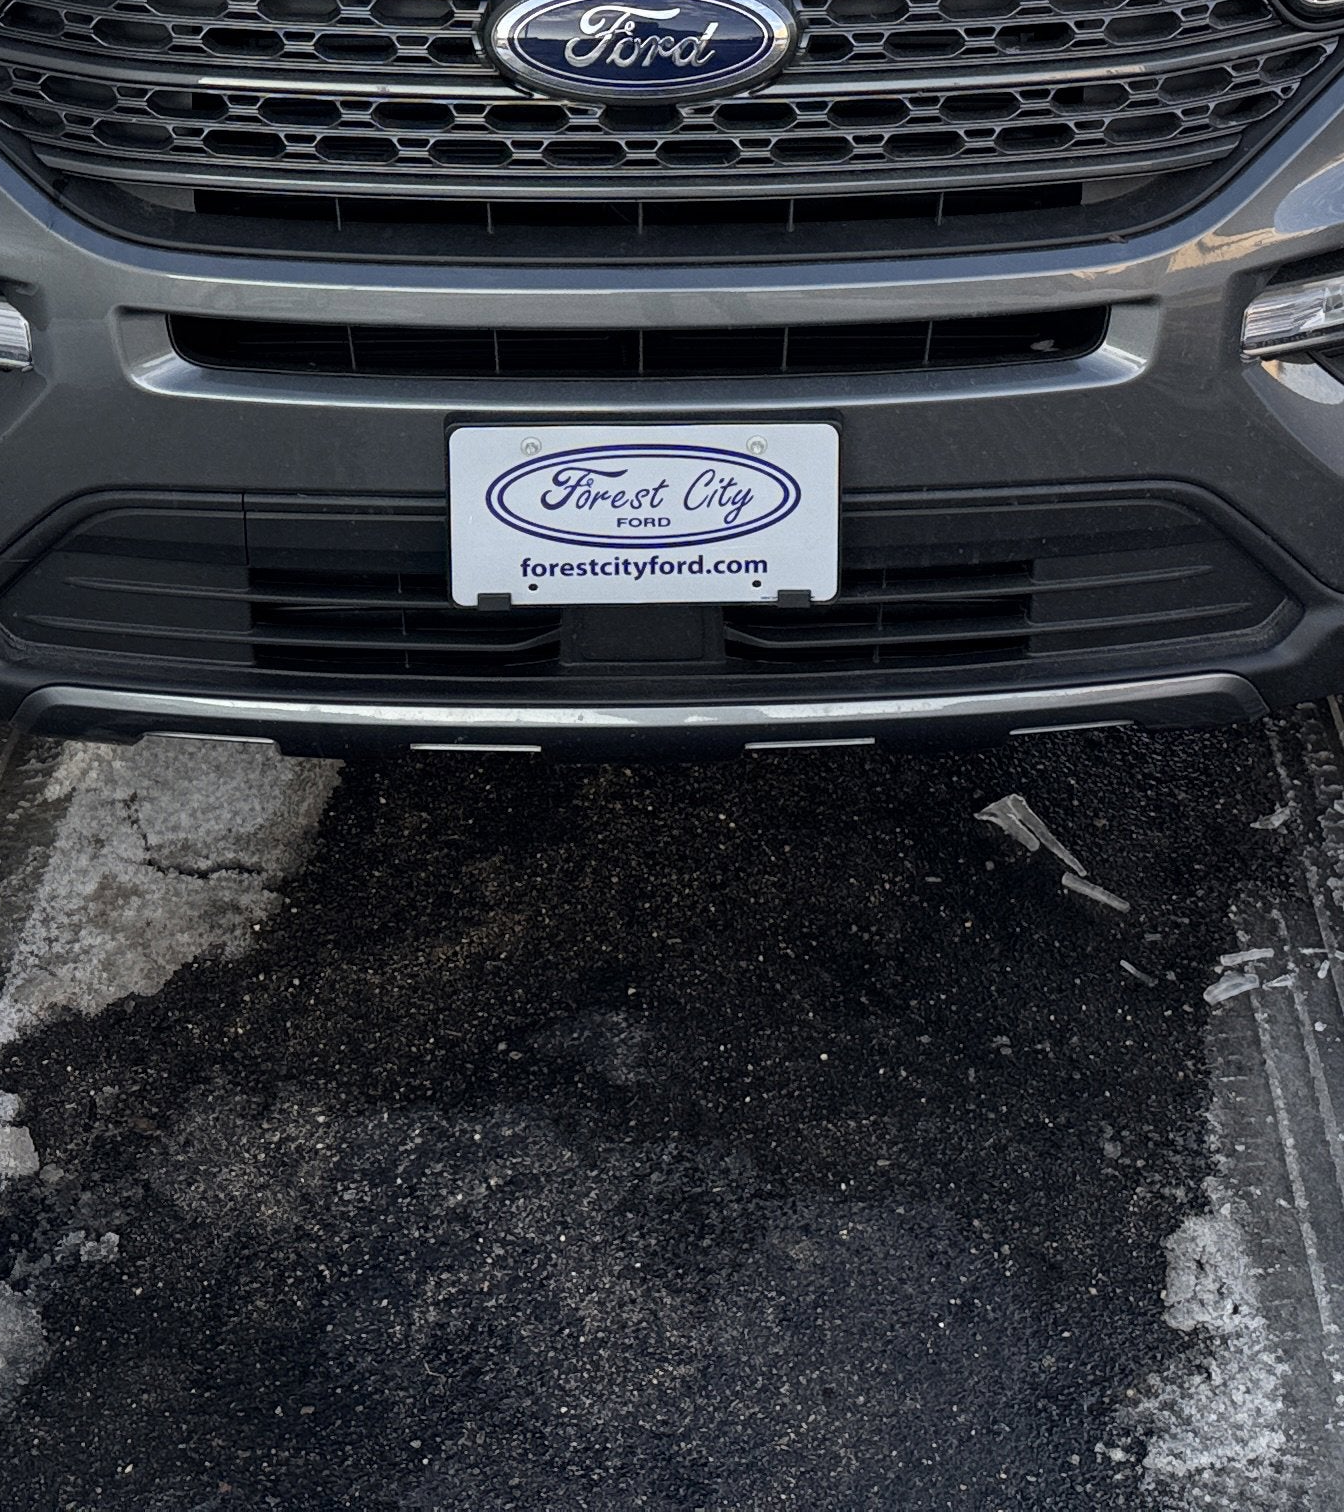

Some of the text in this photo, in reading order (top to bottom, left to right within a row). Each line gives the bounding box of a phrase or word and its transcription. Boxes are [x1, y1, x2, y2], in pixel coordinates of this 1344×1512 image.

[564, 5, 719, 69] Ford
[540, 466, 755, 524] Forest City
[616, 516, 672, 528] FORD
[520, 554, 768, 580] forestcityford.com
